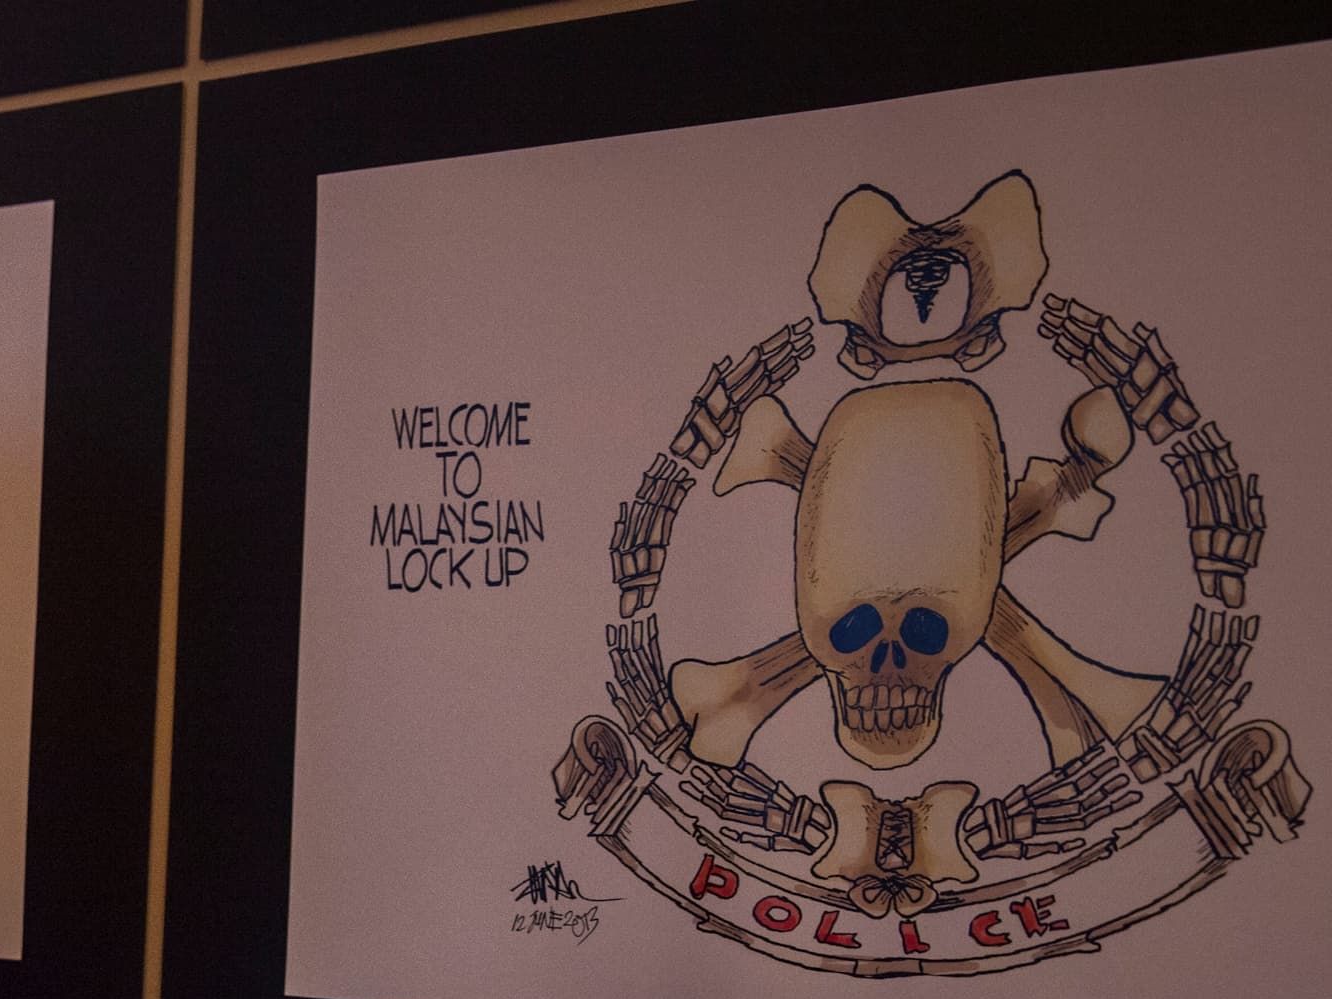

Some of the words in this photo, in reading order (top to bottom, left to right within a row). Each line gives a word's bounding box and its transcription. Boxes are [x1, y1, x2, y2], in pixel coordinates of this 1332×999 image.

[392, 402, 531, 449] WELCOME
[435, 451, 482, 498] TO
[370, 500, 544, 546] MALAYSIAN
[386, 548, 474, 592] LOCK
[485, 547, 529, 587] UP
[689, 853, 1070, 956] POLICE
